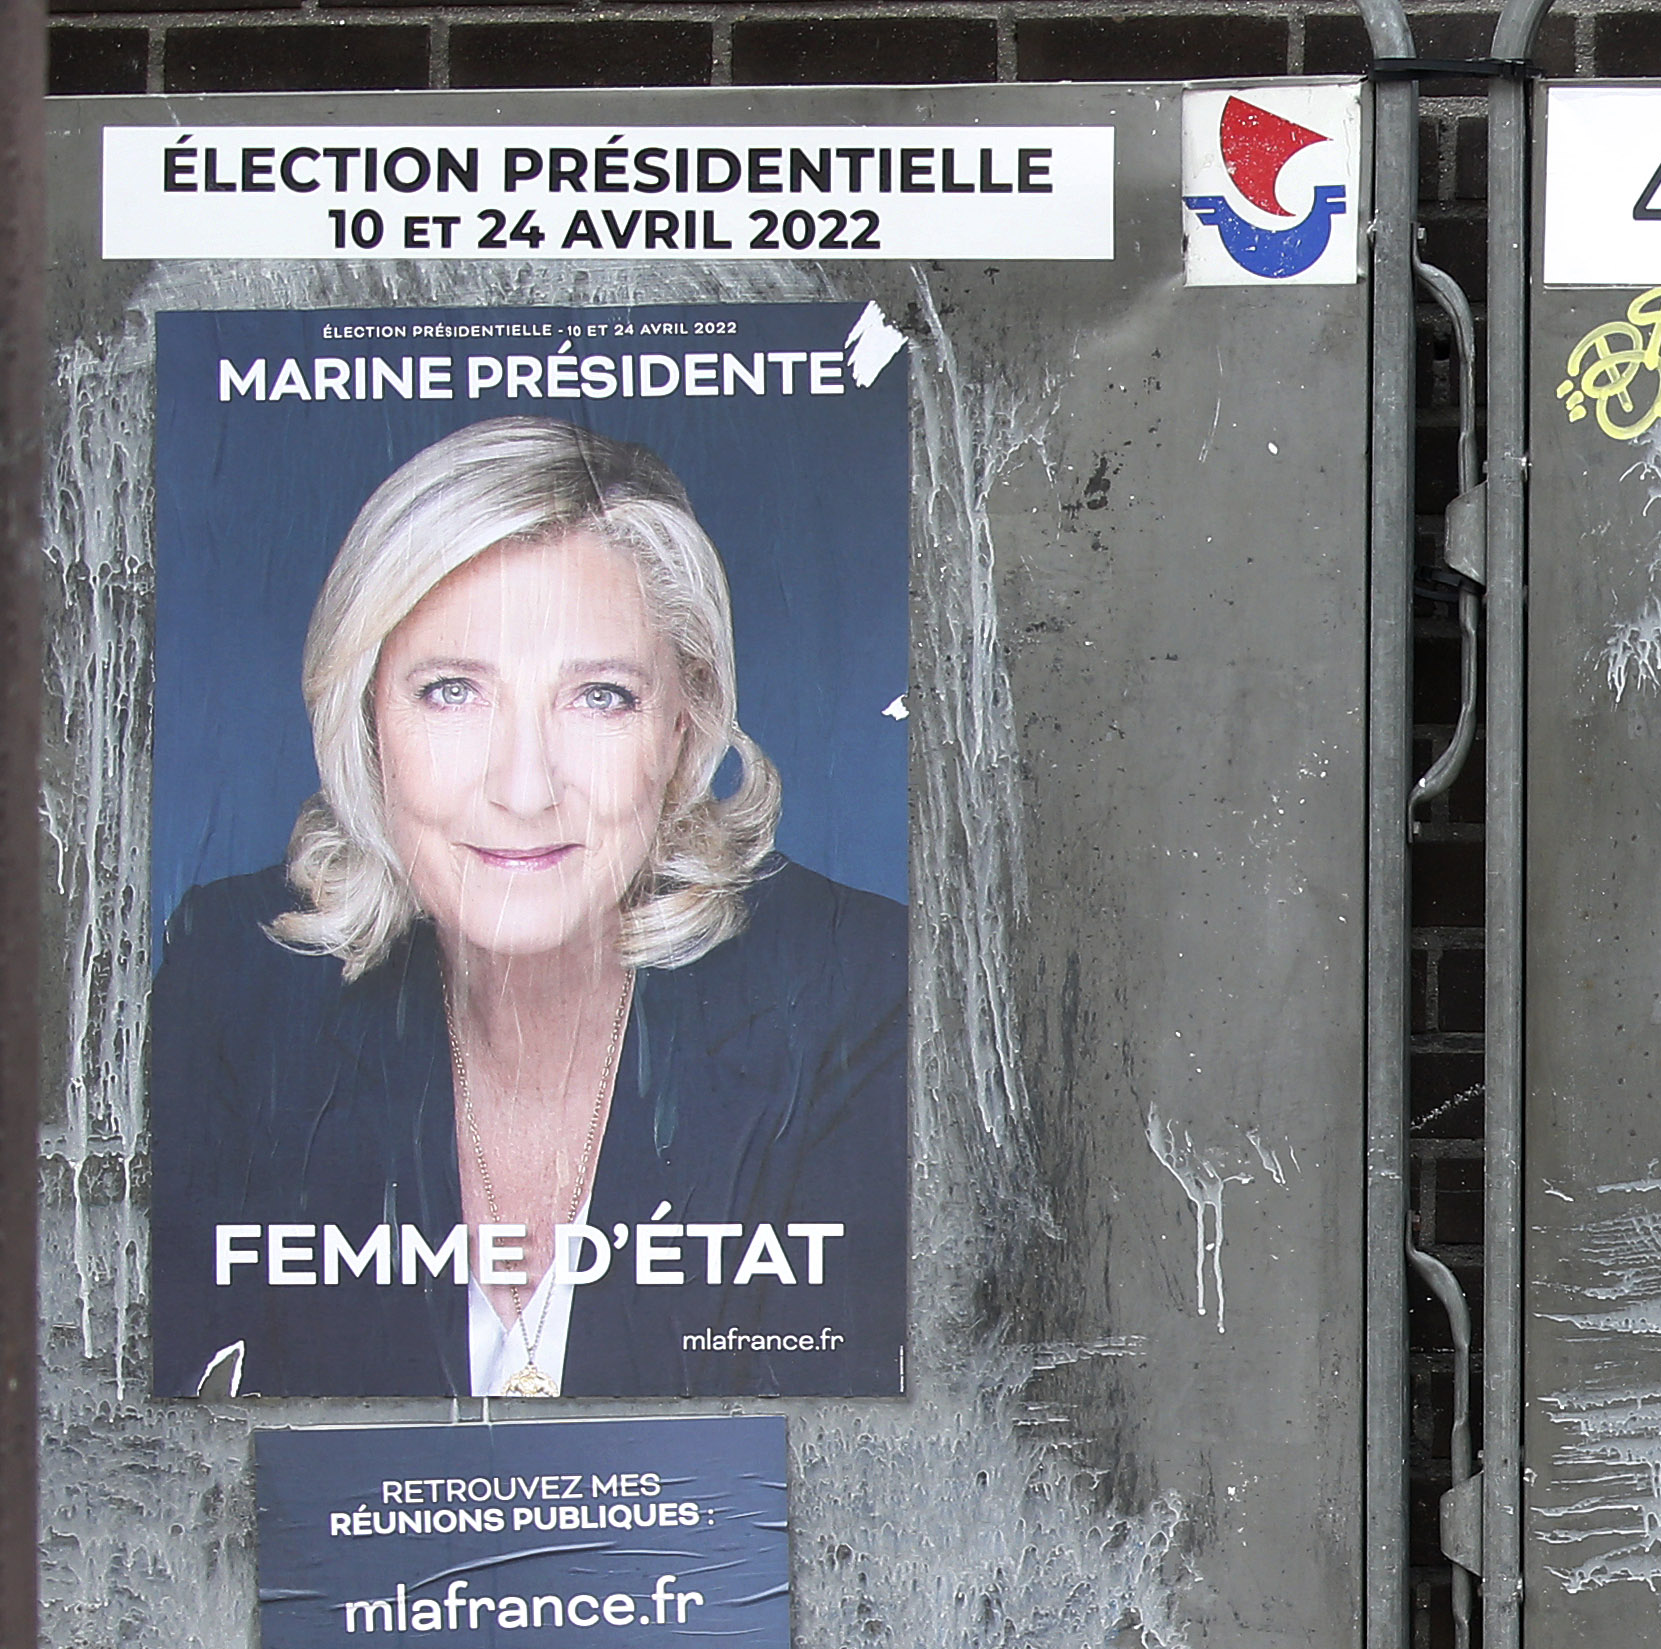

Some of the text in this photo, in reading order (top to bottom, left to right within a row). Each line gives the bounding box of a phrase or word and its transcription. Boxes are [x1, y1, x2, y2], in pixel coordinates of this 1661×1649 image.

[163, 134, 1053, 194] ÉLECTION PRÉSIDENTIELLE
[328, 208, 881, 250] 10 ET 24 AVRIL 2022
[323, 323, 406, 339] ÉLECTION
[412, 322, 552, 338] PRÉSIDENTIELLE
[567, 325, 582, 337] 10
[587, 324, 608, 337] ET
[614, 323, 634, 336] 24
[640, 322, 689, 335] AVRIL
[694, 321, 737, 334] 2022
[219, 342, 846, 402] MARINE PRÉSIDENTE
[214, 1200, 845, 1287] FEMME D'ÉTAT
[683, 1327, 844, 1351] mlafrance.fr
[381, 1472, 662, 1504] RETROUVEZ MES
[330, 1502, 506, 1538] RÉUNIONS
[512, 1501, 701, 1534] PUBLIQUES
[344, 1574, 705, 1634] mlafrance.fr
